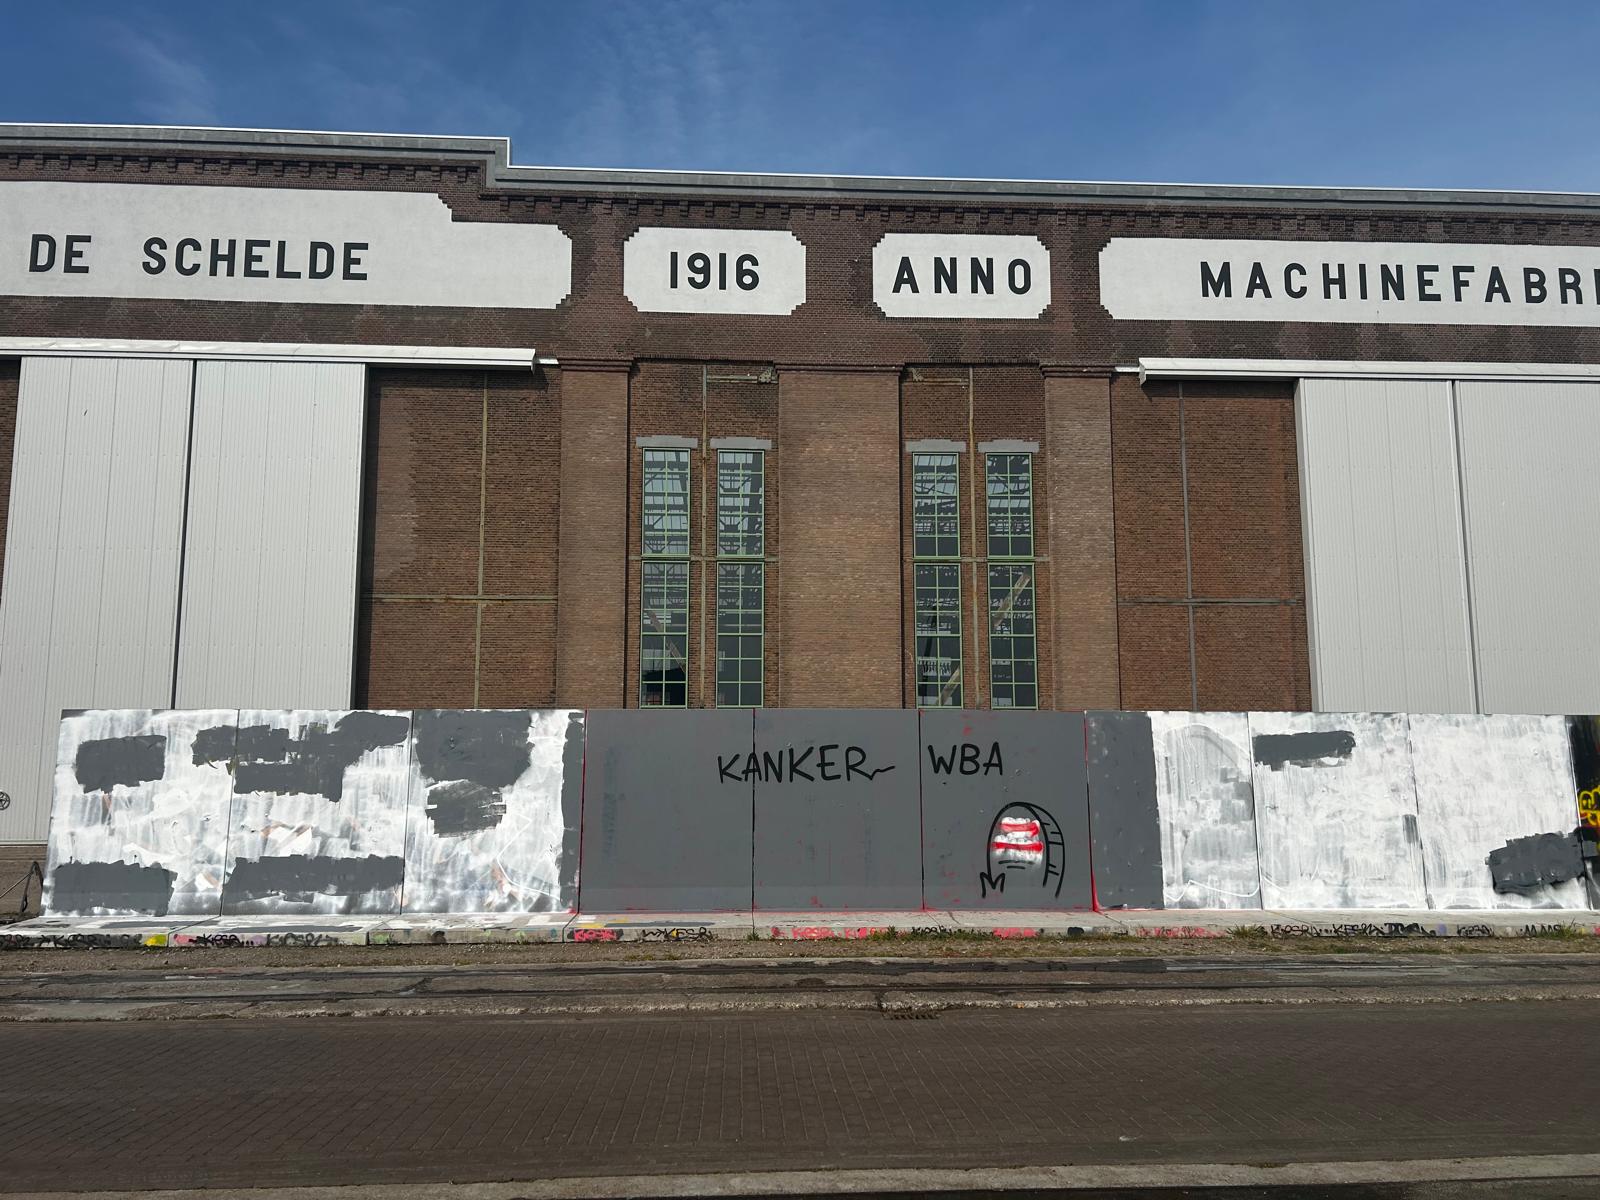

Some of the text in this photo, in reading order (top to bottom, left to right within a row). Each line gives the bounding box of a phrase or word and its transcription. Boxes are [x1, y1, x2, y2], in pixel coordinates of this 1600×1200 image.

[29, 234, 369, 280] DE SCHELDE
[670, 252, 760, 291] 1916
[892, 256, 1032, 295] ANNO
[717, 745, 895, 783] KANKER
[928, 742, 1003, 776] WBA
